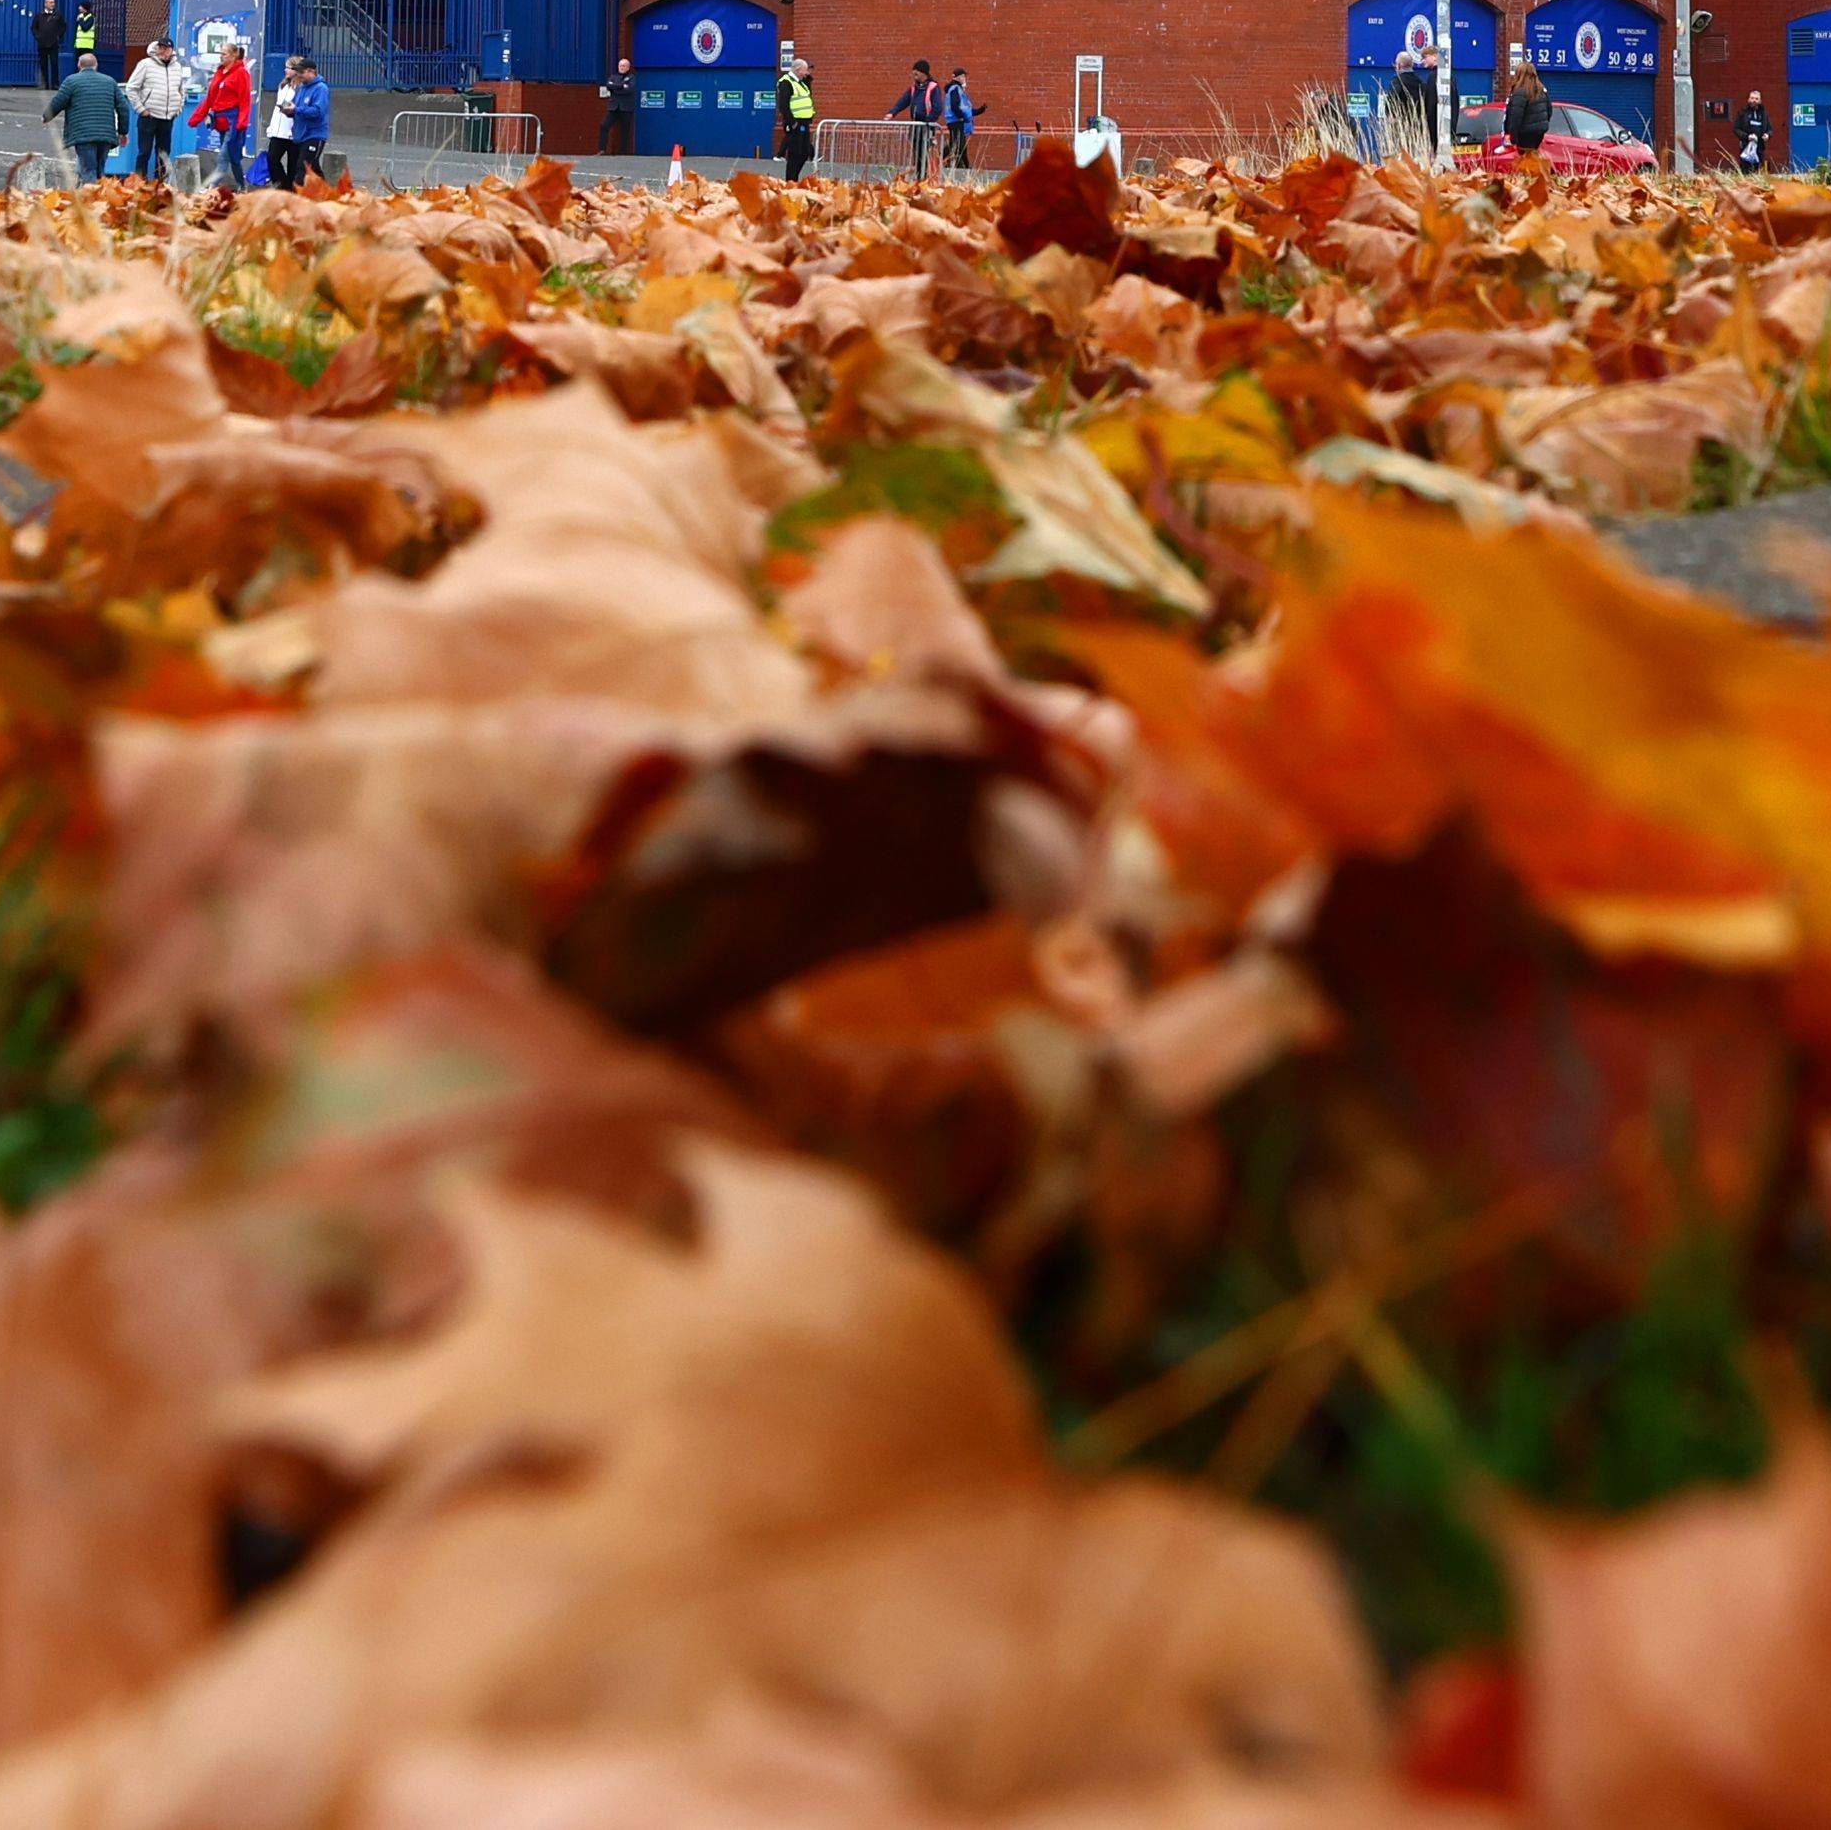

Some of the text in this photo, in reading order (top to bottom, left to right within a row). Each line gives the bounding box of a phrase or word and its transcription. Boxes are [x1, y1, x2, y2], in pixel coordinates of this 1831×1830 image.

[1815, 31, 1828, 39] EXIT
[1538, 49, 1550, 63] 52
[1556, 50, 1566, 63] 51
[1608, 51, 1654, 67] 50 49 48
